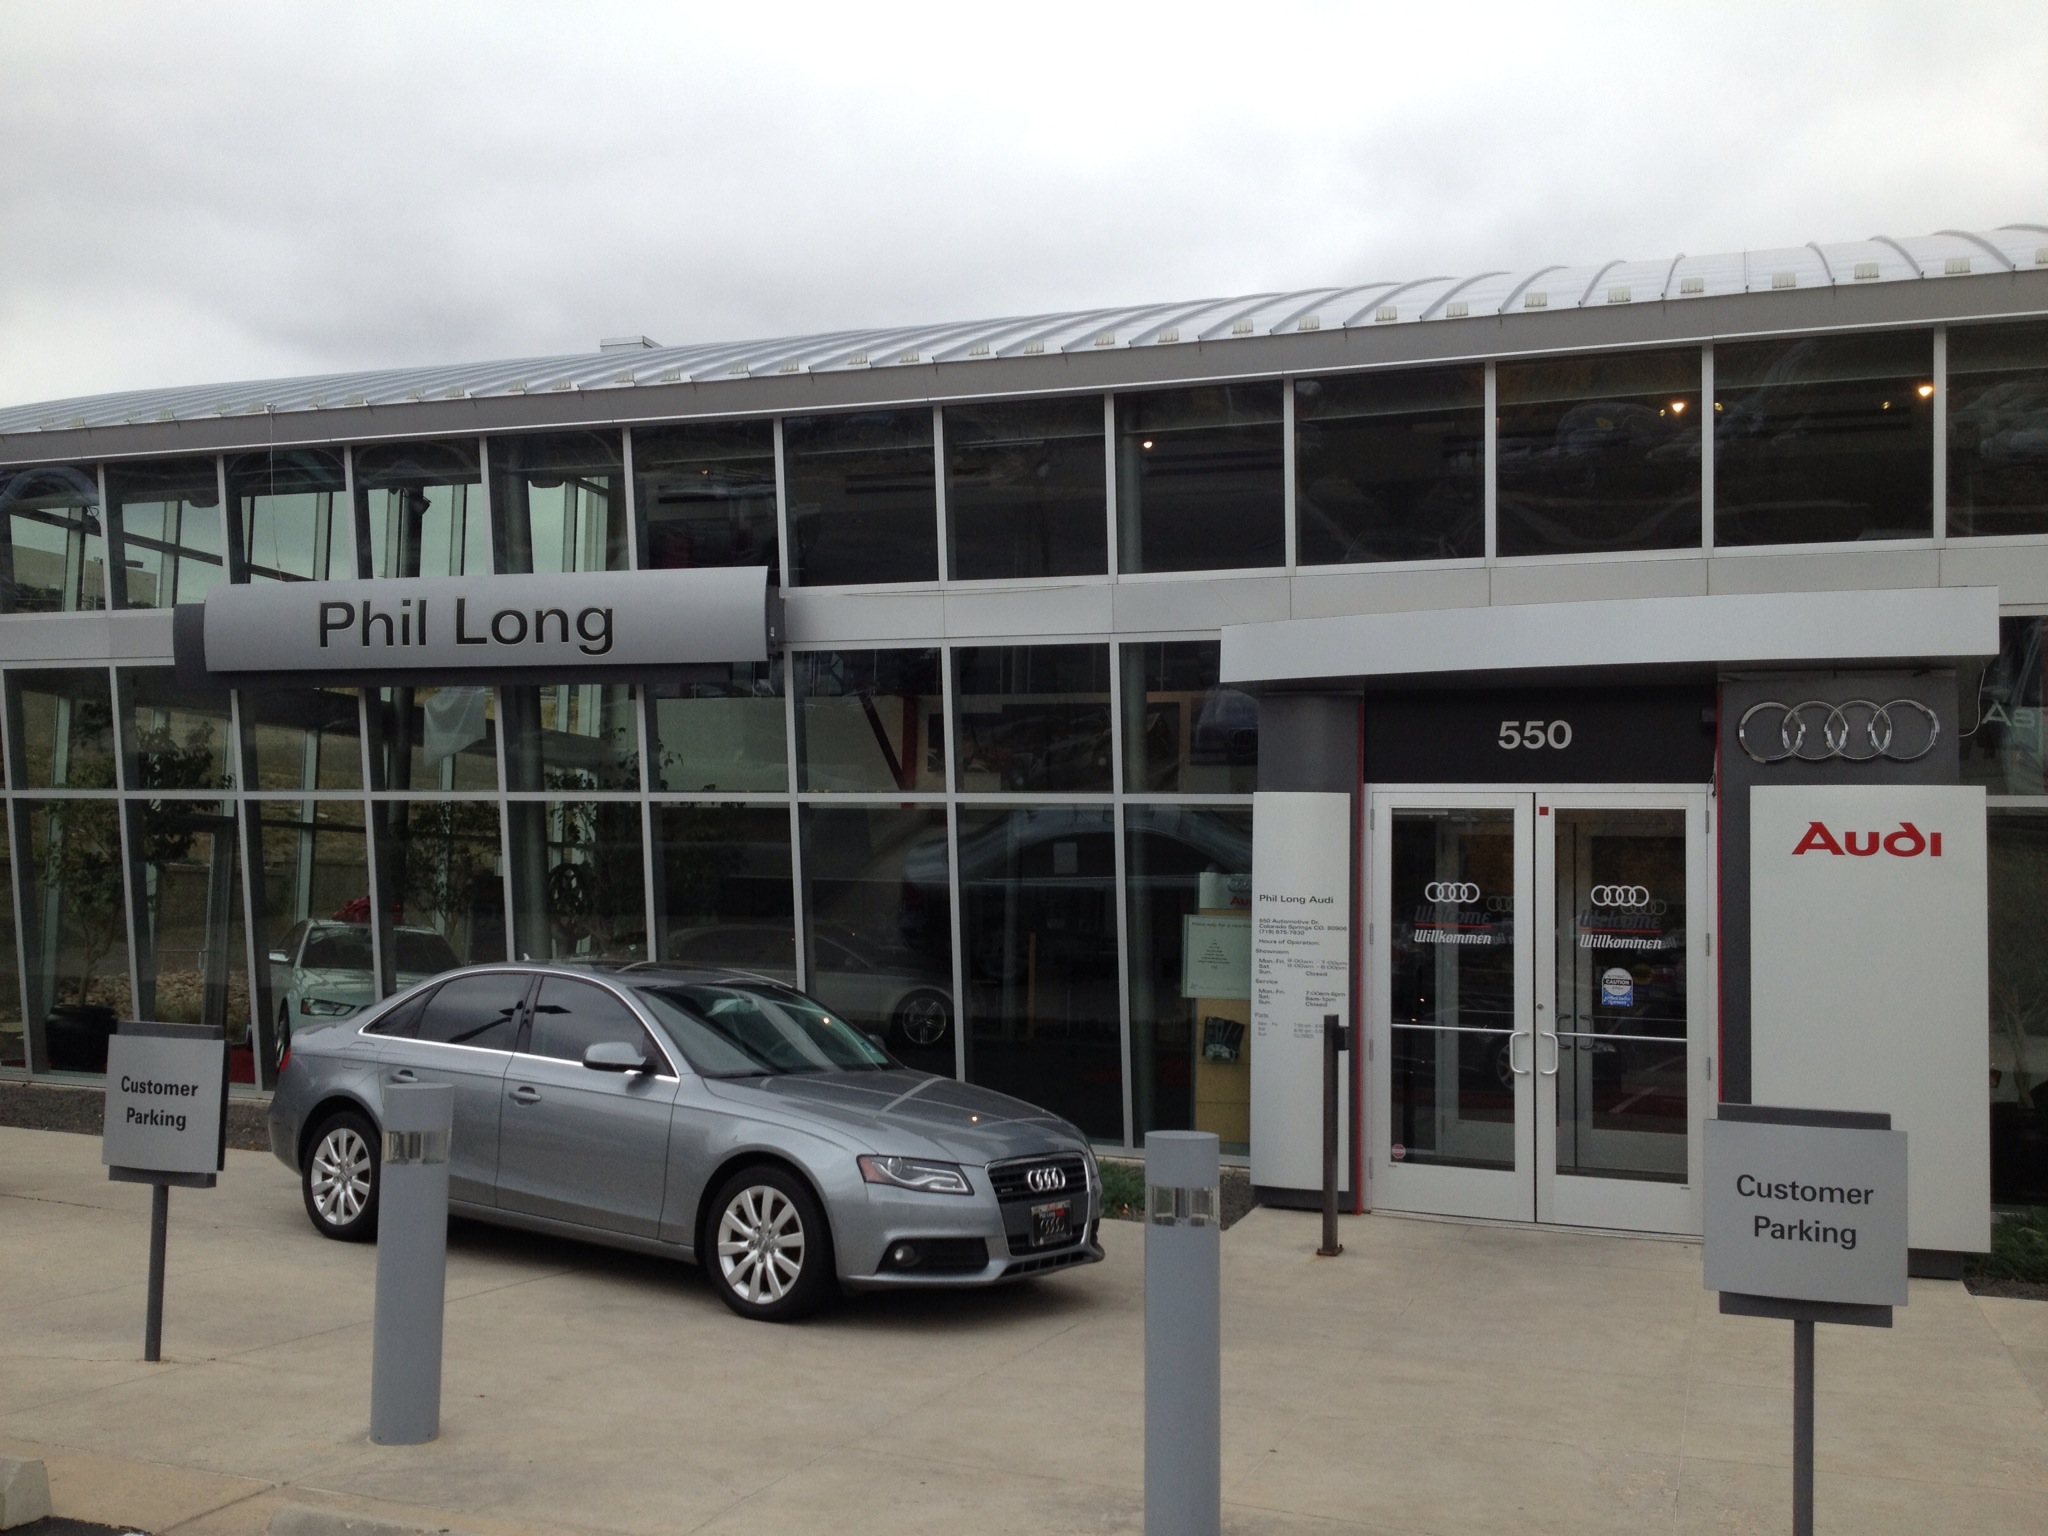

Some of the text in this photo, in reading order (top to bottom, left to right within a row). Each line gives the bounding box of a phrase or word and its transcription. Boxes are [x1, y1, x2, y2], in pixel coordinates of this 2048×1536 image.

[320, 597, 613, 655] Phil Long
[1498, 720, 1572, 749] 550
[1792, 822, 1941, 857] Audi
[1260, 894, 1334, 905] Phil Long Audi
[1414, 929, 1491, 944] Willkommen
[1580, 934, 1662, 949] Willkommen
[121, 1075, 199, 1097] Customer
[126, 1106, 187, 1132] Parking
[1736, 1174, 1874, 1205] Customer
[1754, 1215, 1857, 1250] Parking
